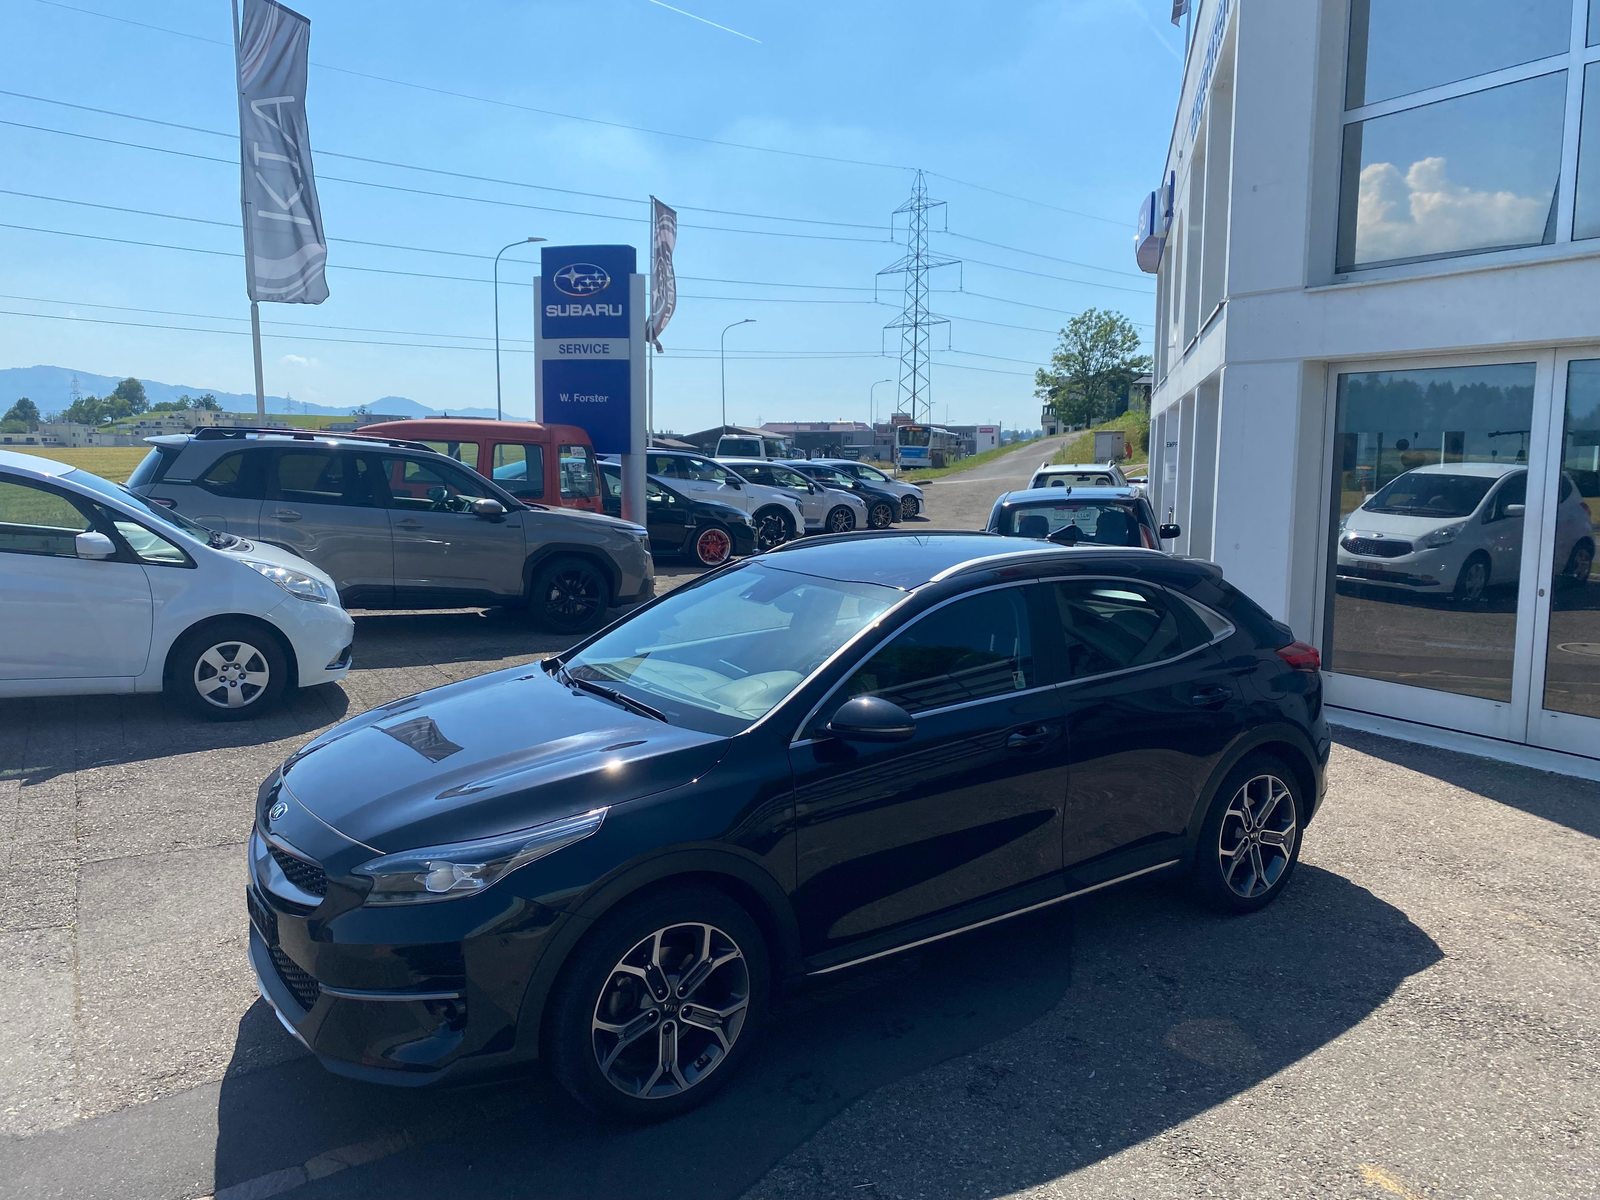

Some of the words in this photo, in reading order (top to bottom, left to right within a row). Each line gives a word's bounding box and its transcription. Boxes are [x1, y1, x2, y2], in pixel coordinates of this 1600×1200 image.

[251, 96, 311, 226] KIA
[546, 304, 622, 316] SUBARU
[559, 343, 609, 354] SERVICE
[560, 393, 571, 402] W.
[574, 393, 609, 402] Forster
